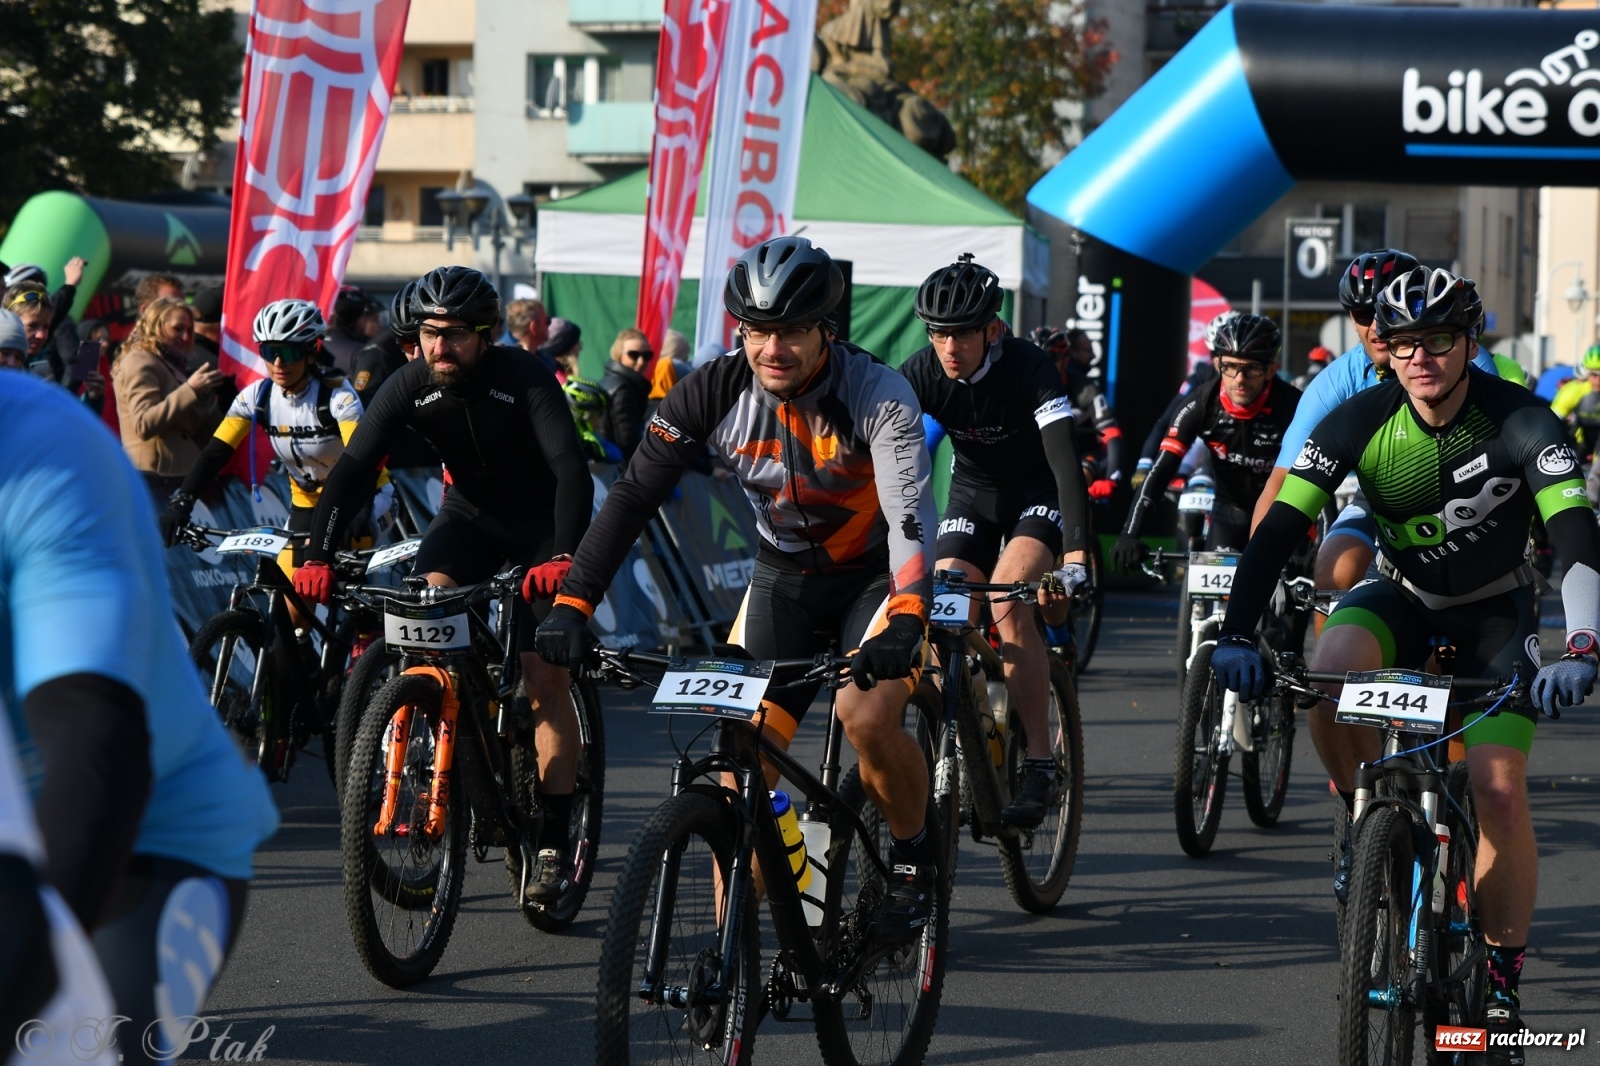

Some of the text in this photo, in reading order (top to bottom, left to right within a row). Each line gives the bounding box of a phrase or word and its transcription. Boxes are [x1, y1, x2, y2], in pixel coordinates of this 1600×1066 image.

[1402, 67, 1549, 136] bike
[1296, 237, 1327, 279] 0
[414, 390, 442, 408] FUSION
[489, 388, 515, 404] FUSION
[1305, 444, 1339, 473] kiwi
[1458, 461, 1484, 479] ŁUKASZ
[898, 465, 920, 511] NOVA
[322, 506, 340, 551] BRUBECK
[231, 536, 275, 548] 1189
[1417, 518, 1499, 564] KLUB MTB
[382, 543, 420, 560] 220
[1201, 573, 1233, 589] 142
[931, 601, 957, 617] 96
[398, 624, 456, 643] 1129
[675, 678, 745, 700] 1291
[1355, 690, 1429, 713] 2144
[893, 863, 917, 875] SIDI
[1416, 929, 1430, 975] ROCKSHOX
[1487, 1008, 1510, 1019] SIDI
